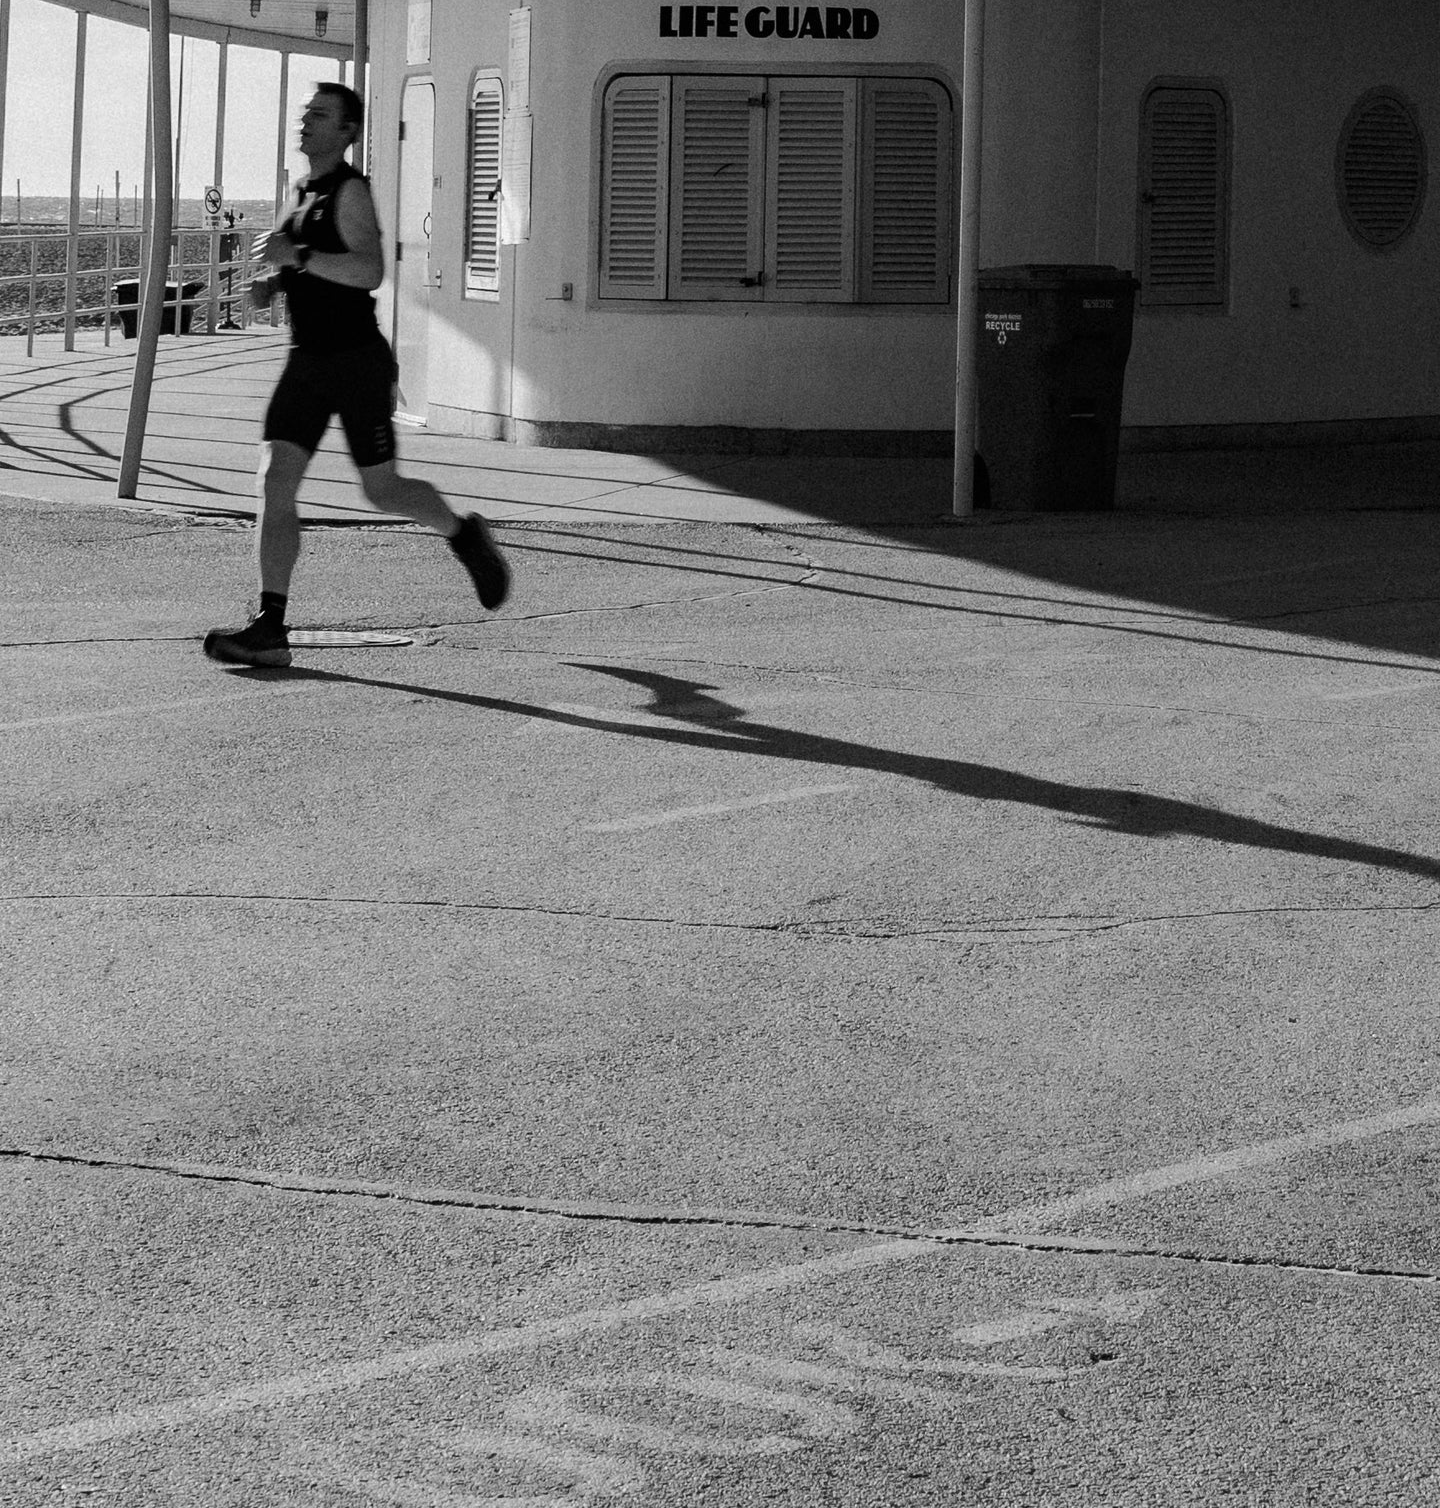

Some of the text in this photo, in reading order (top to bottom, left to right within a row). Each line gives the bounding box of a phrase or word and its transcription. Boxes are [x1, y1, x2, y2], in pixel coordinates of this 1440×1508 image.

[660, 5, 880, 40] LIFE GUARD
[985, 321, 1021, 331] RECYCLE
